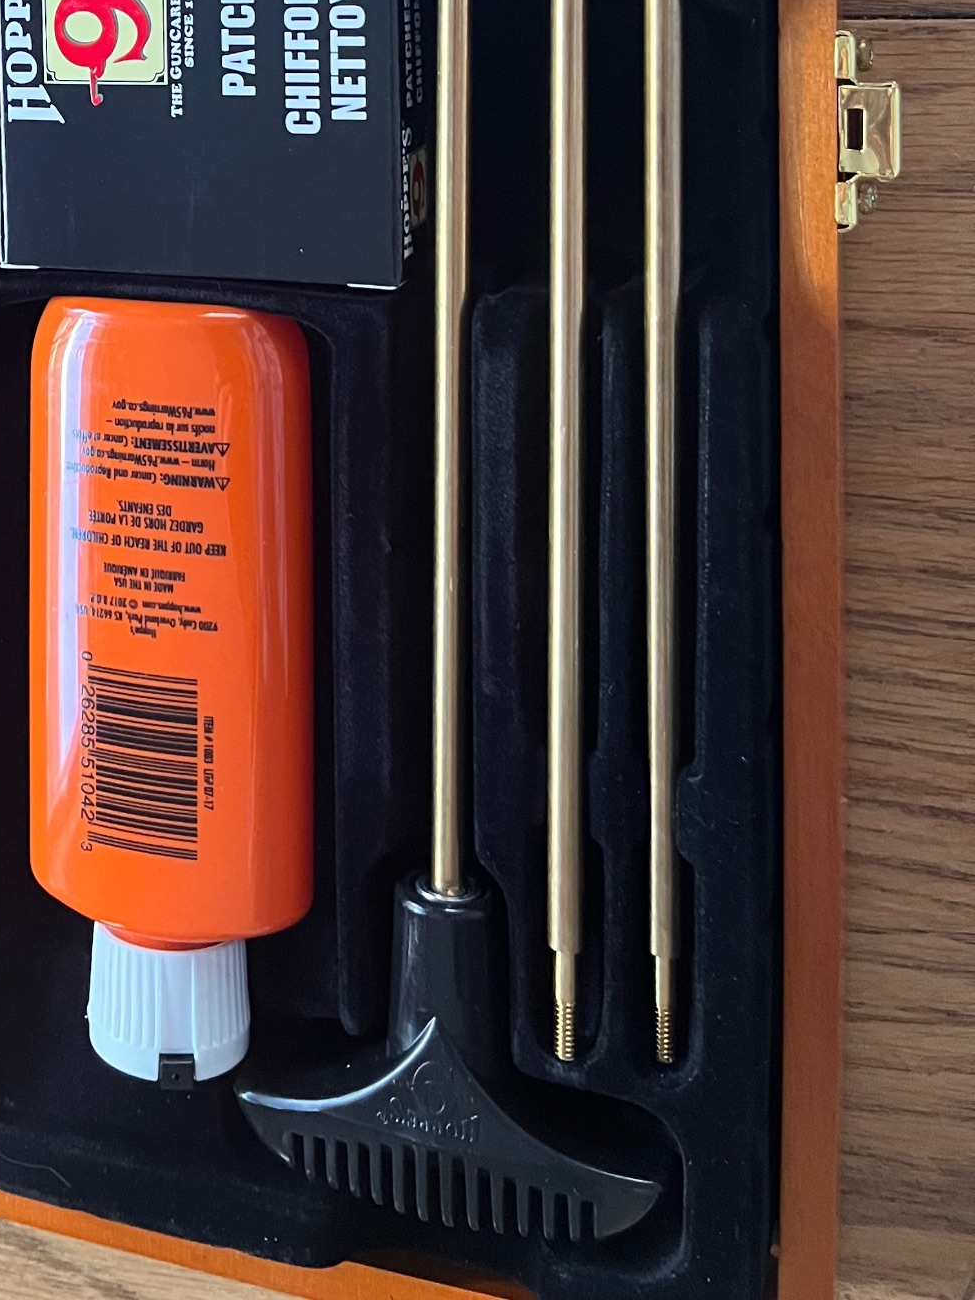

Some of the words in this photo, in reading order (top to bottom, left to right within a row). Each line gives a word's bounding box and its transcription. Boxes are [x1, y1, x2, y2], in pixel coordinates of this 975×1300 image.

[184, 14, 194, 68] SINCE
[170, 83, 183, 118] THE
[112, 400, 215, 418] www.P65Warnings.ca.gov
[115, 418, 163, 432] reproduction
[167, 423, 174, 435] la
[177, 424, 188, 432] sur
[192, 425, 215, 437] nocifs
[104, 434, 128, 447] Cancer
[131, 437, 215, 454] AVERTISSEMENT:
[66, 462, 111, 478] Reproductive
[192, 459, 215, 471] Harm
[114, 468, 128, 480] and
[131, 471, 157, 484] Cancer
[160, 473, 215, 489] WARNING:
[117, 500, 153, 515] ENFANTS.
[157, 504, 171, 516] DES
[88, 510, 116, 525] PORTÉE
[119, 514, 128, 526] LA
[131, 515, 141, 527] DE
[145, 518, 166, 530] HORS
[170, 520, 203, 533] GARDEZ
[70, 527, 108, 544] CHILDREN.
[111, 535, 121, 546] OF
[124, 536, 150, 549] REACH
[153, 539, 168, 552] THE
[171, 541, 181, 553] OF
[185, 542, 202, 555] OUT
[205, 544, 226, 556] KEEP
[104, 563, 137, 578] AMÉRIQUE
[140, 567, 149, 578] EN
[151, 569, 185, 582] FABRIQUÉ
[114, 577, 127, 588] USA
[130, 580, 141, 590] THE
[144, 581, 151, 591] IN
[154, 582, 173, 593] MADE
[110, 596, 127, 608] 2017
[114, 610, 123, 621] KS
[126, 611, 142, 625] Park,
[145, 615, 176, 628] Overland
[130, 626, 156, 638] Hoppe's
[199, 621, 218, 631] 9200
[82, 651, 92, 661] 0
[81, 684, 95, 748] 26285
[204, 716, 213, 733] ITEM
[81, 756, 94, 819] 51042
[81, 841, 92, 851] 3
